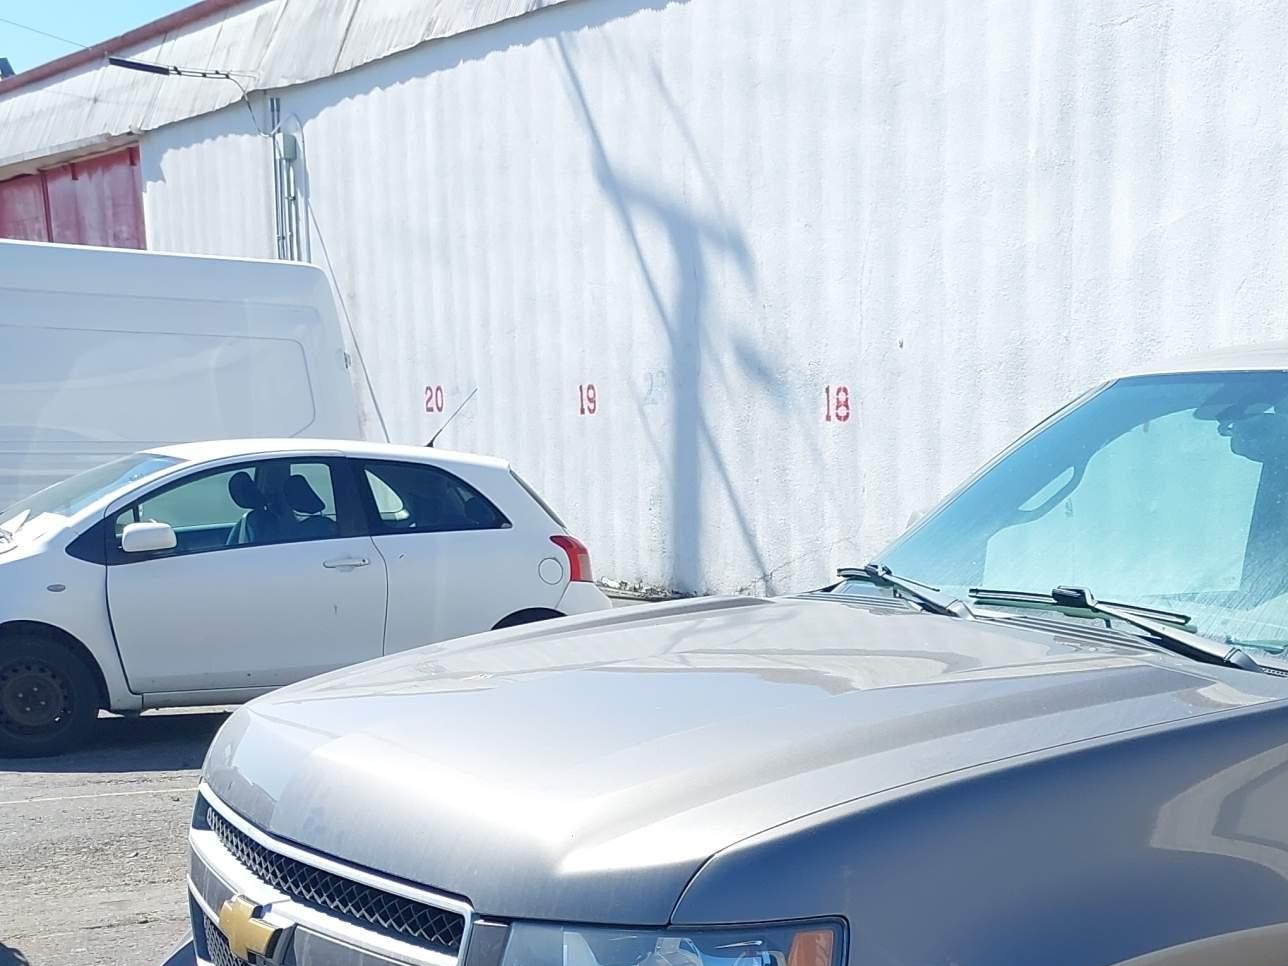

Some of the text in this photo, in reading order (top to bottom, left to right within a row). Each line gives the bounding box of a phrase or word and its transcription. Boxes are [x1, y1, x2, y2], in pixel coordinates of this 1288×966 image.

[424, 385, 444, 413] 20
[578, 384, 597, 415] 19
[825, 385, 850, 422] 18
